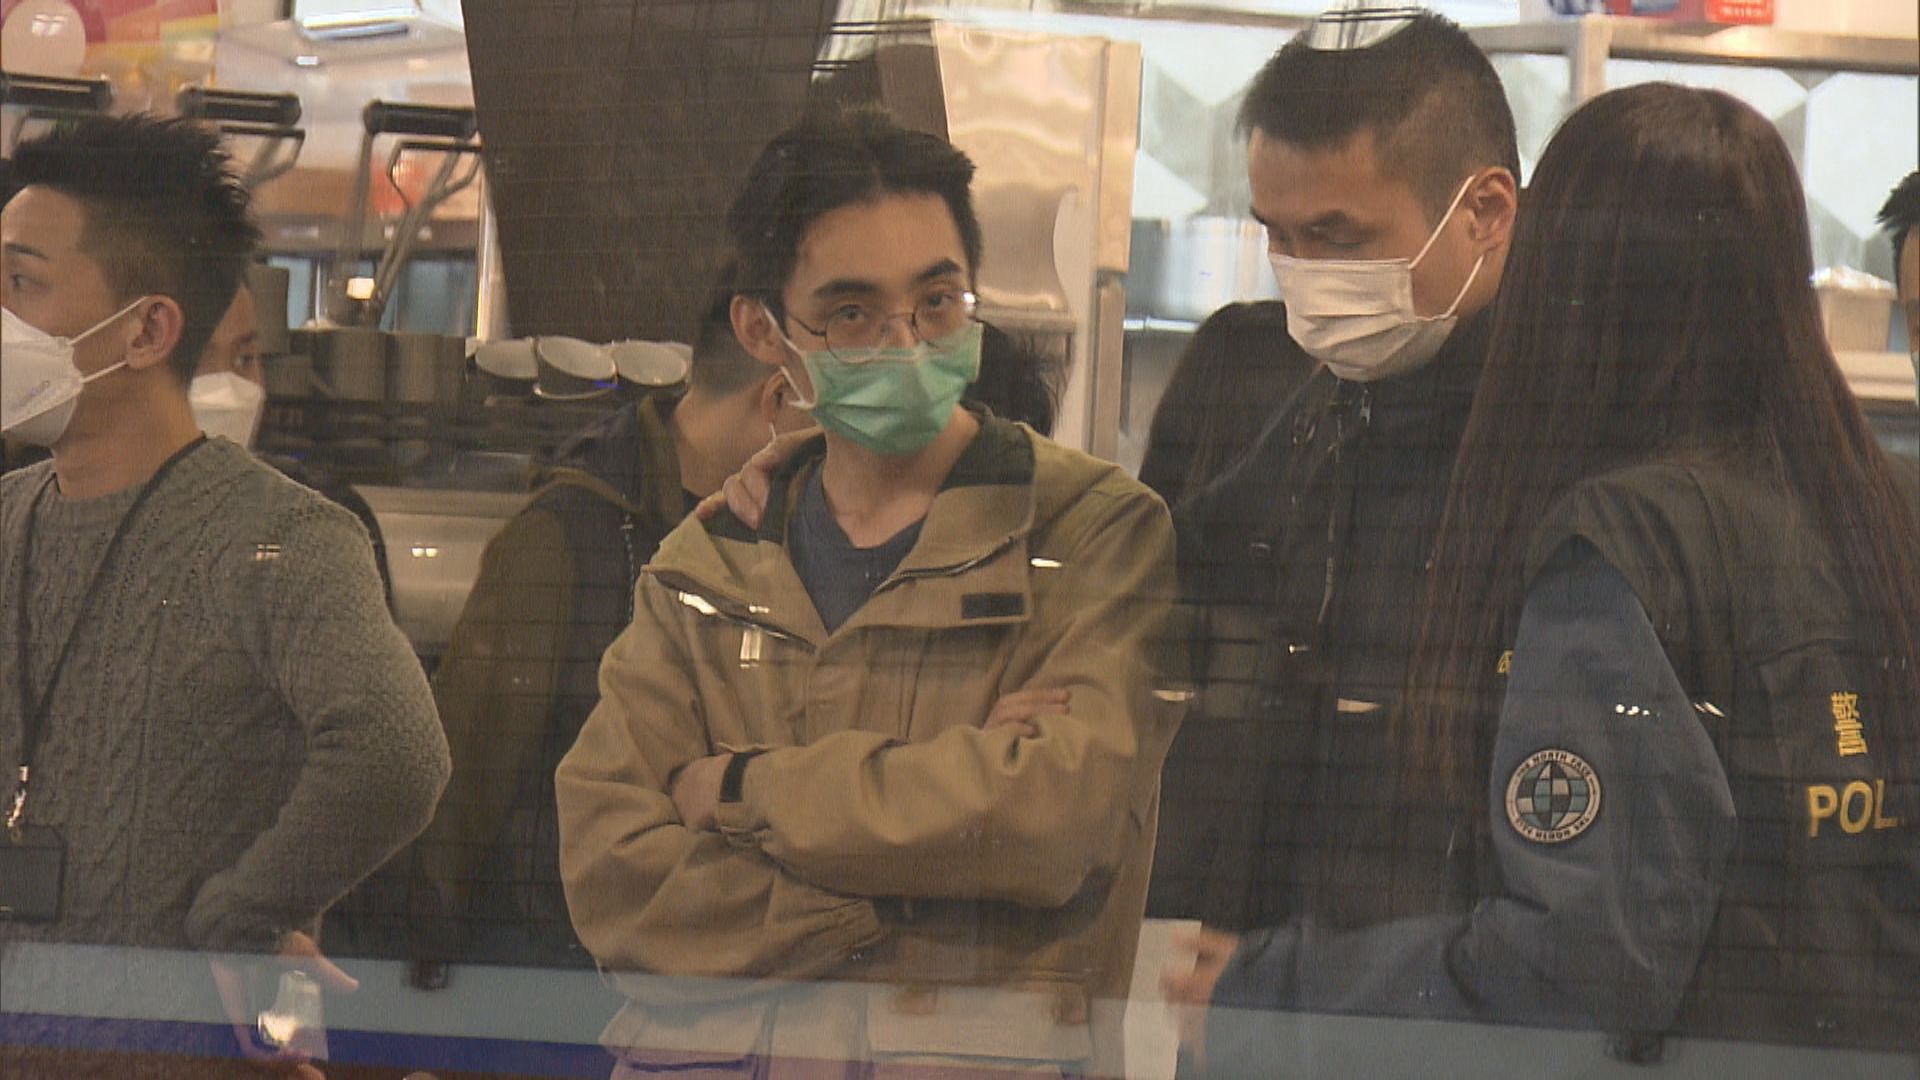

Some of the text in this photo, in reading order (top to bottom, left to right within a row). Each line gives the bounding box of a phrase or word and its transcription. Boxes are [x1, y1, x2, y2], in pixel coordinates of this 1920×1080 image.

[1831, 691, 1868, 757] 警
[1532, 752, 1568, 763] NORTH
[1807, 778, 1905, 838] POL
